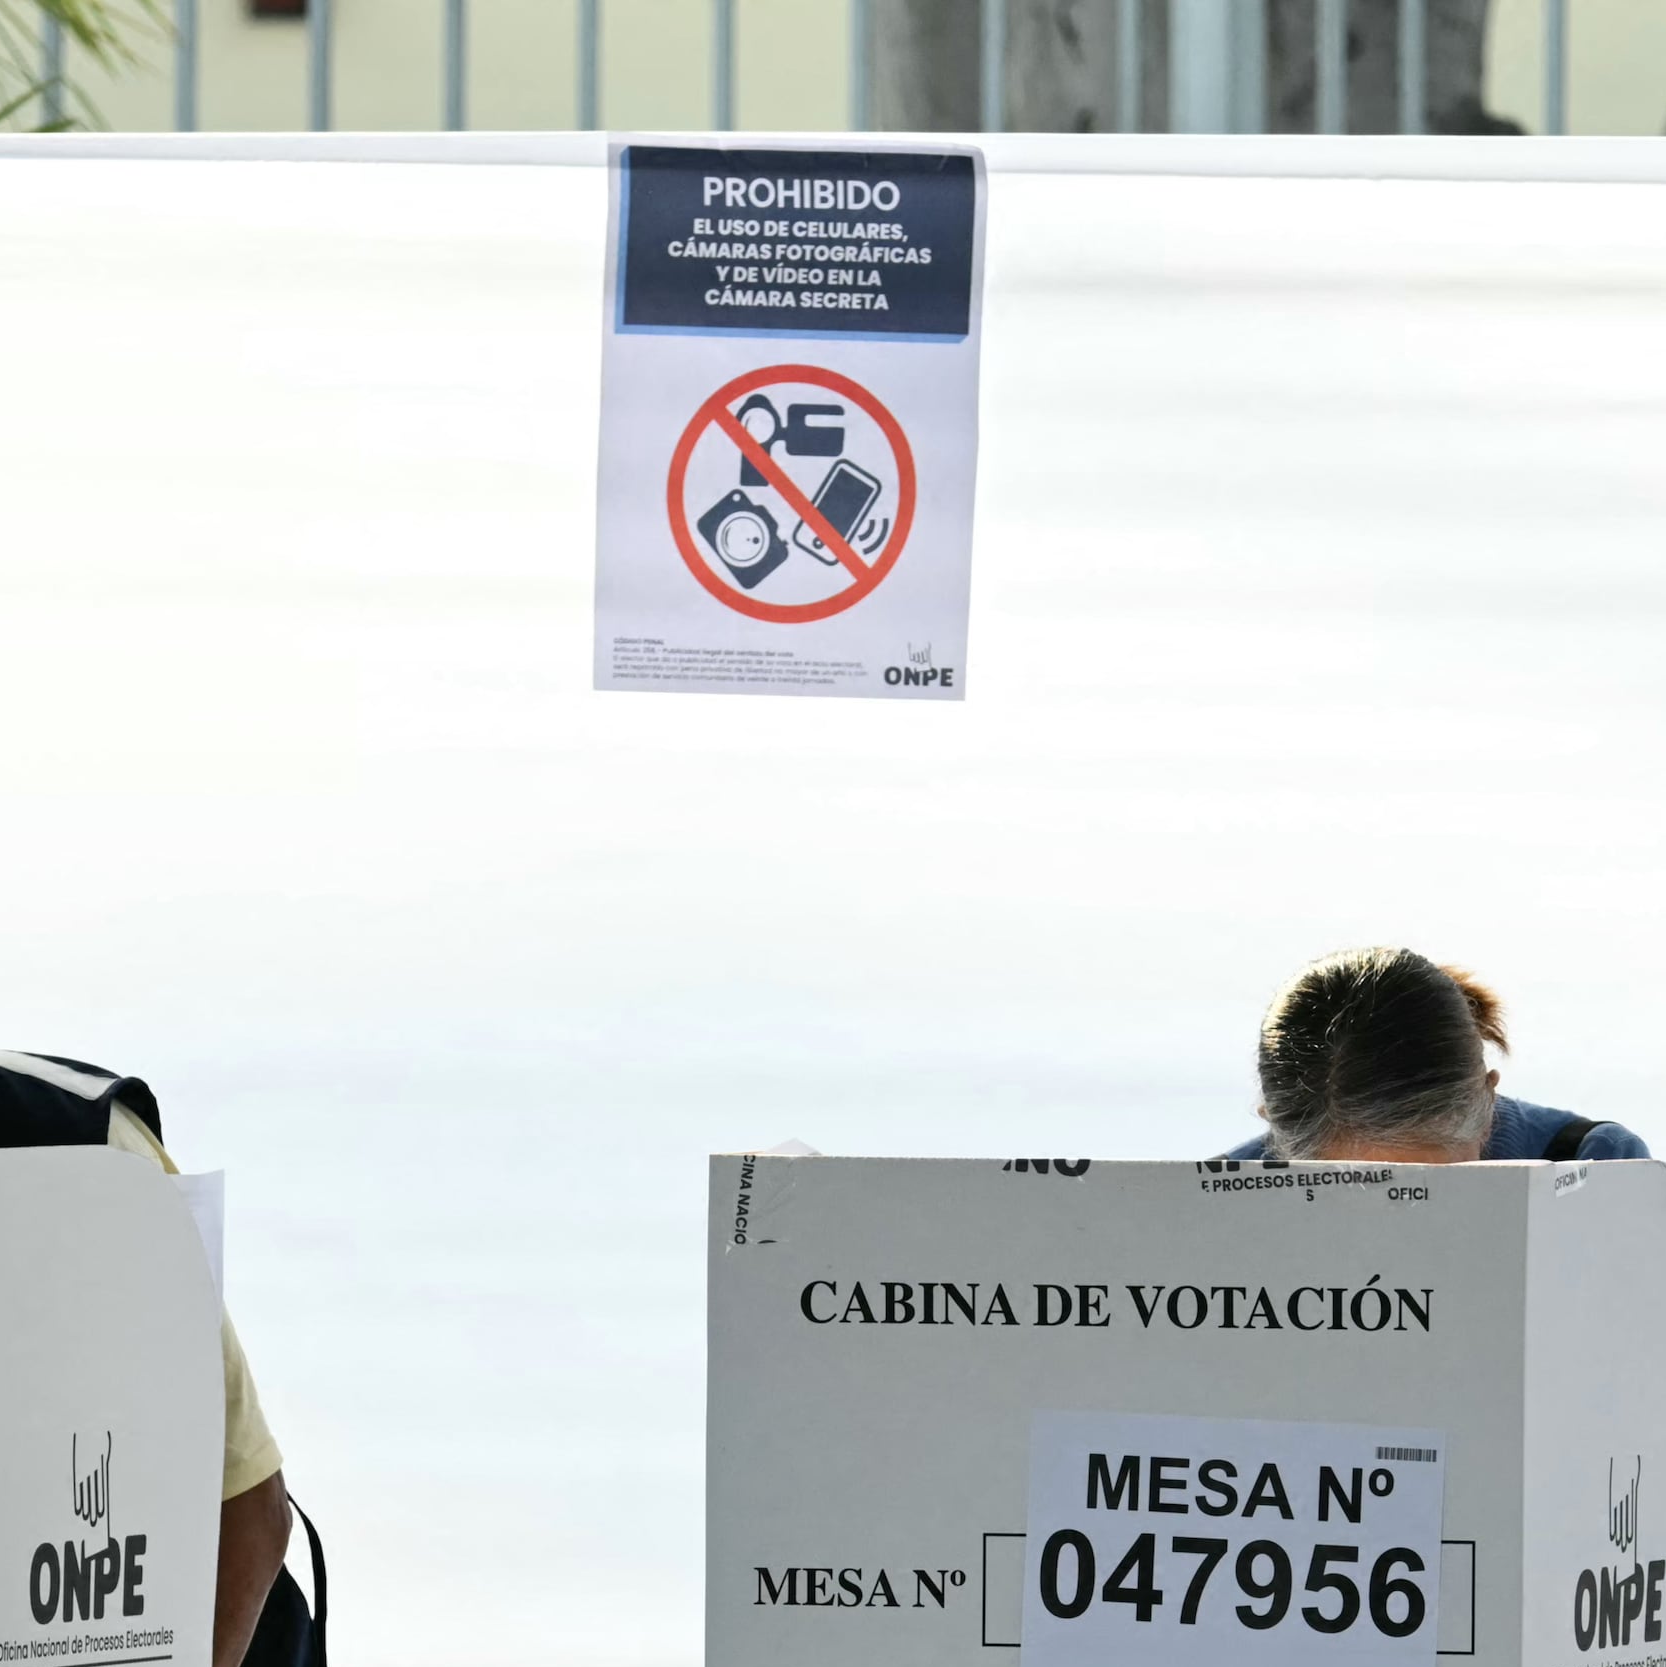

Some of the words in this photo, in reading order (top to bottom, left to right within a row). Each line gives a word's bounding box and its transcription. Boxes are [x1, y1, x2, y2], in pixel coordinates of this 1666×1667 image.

[704, 177, 900, 210] PROHIBIDO
[694, 218, 714, 234] EL
[719, 219, 760, 236] USO
[764, 221, 789, 236] DE
[793, 221, 907, 241] CELULARES,
[668, 237, 771, 259] CÁMARAS
[776, 241, 931, 266] FOTOGRÁFICAS
[716, 266, 729, 281] Y
[733, 266, 758, 282] DE
[763, 263, 824, 284] VÍDEO
[828, 269, 853, 285] EN
[858, 270, 881, 286] LA
[705, 285, 796, 307] CÁMARA
[800, 292, 888, 309] SECRETA
[884, 667, 953, 687] ONPE
[1213, 1174, 1294, 1192] PROCESOS
[1388, 1187, 1429, 1201] OFICI
[801, 1281, 1020, 1325] CABINA
[1033, 1285, 1110, 1326] DE
[1126, 1274, 1434, 1332] VOTACIÓN
[1087, 1454, 1294, 1520] MESA
[1318, 1466, 1394, 1523] Nº
[30, 1534, 146, 1625] ONPE
[754, 1568, 900, 1607] MESA
[913, 1570, 965, 1608] Nº
[1040, 1529, 1425, 1637] 047956
[1575, 1559, 1665, 1651] ONPE
[31, 1637, 69, 1657] Nacional
[72, 1636, 82, 1652] de
[85, 1635, 124, 1652] Procesos
[127, 1627, 173, 1648] Electorales
